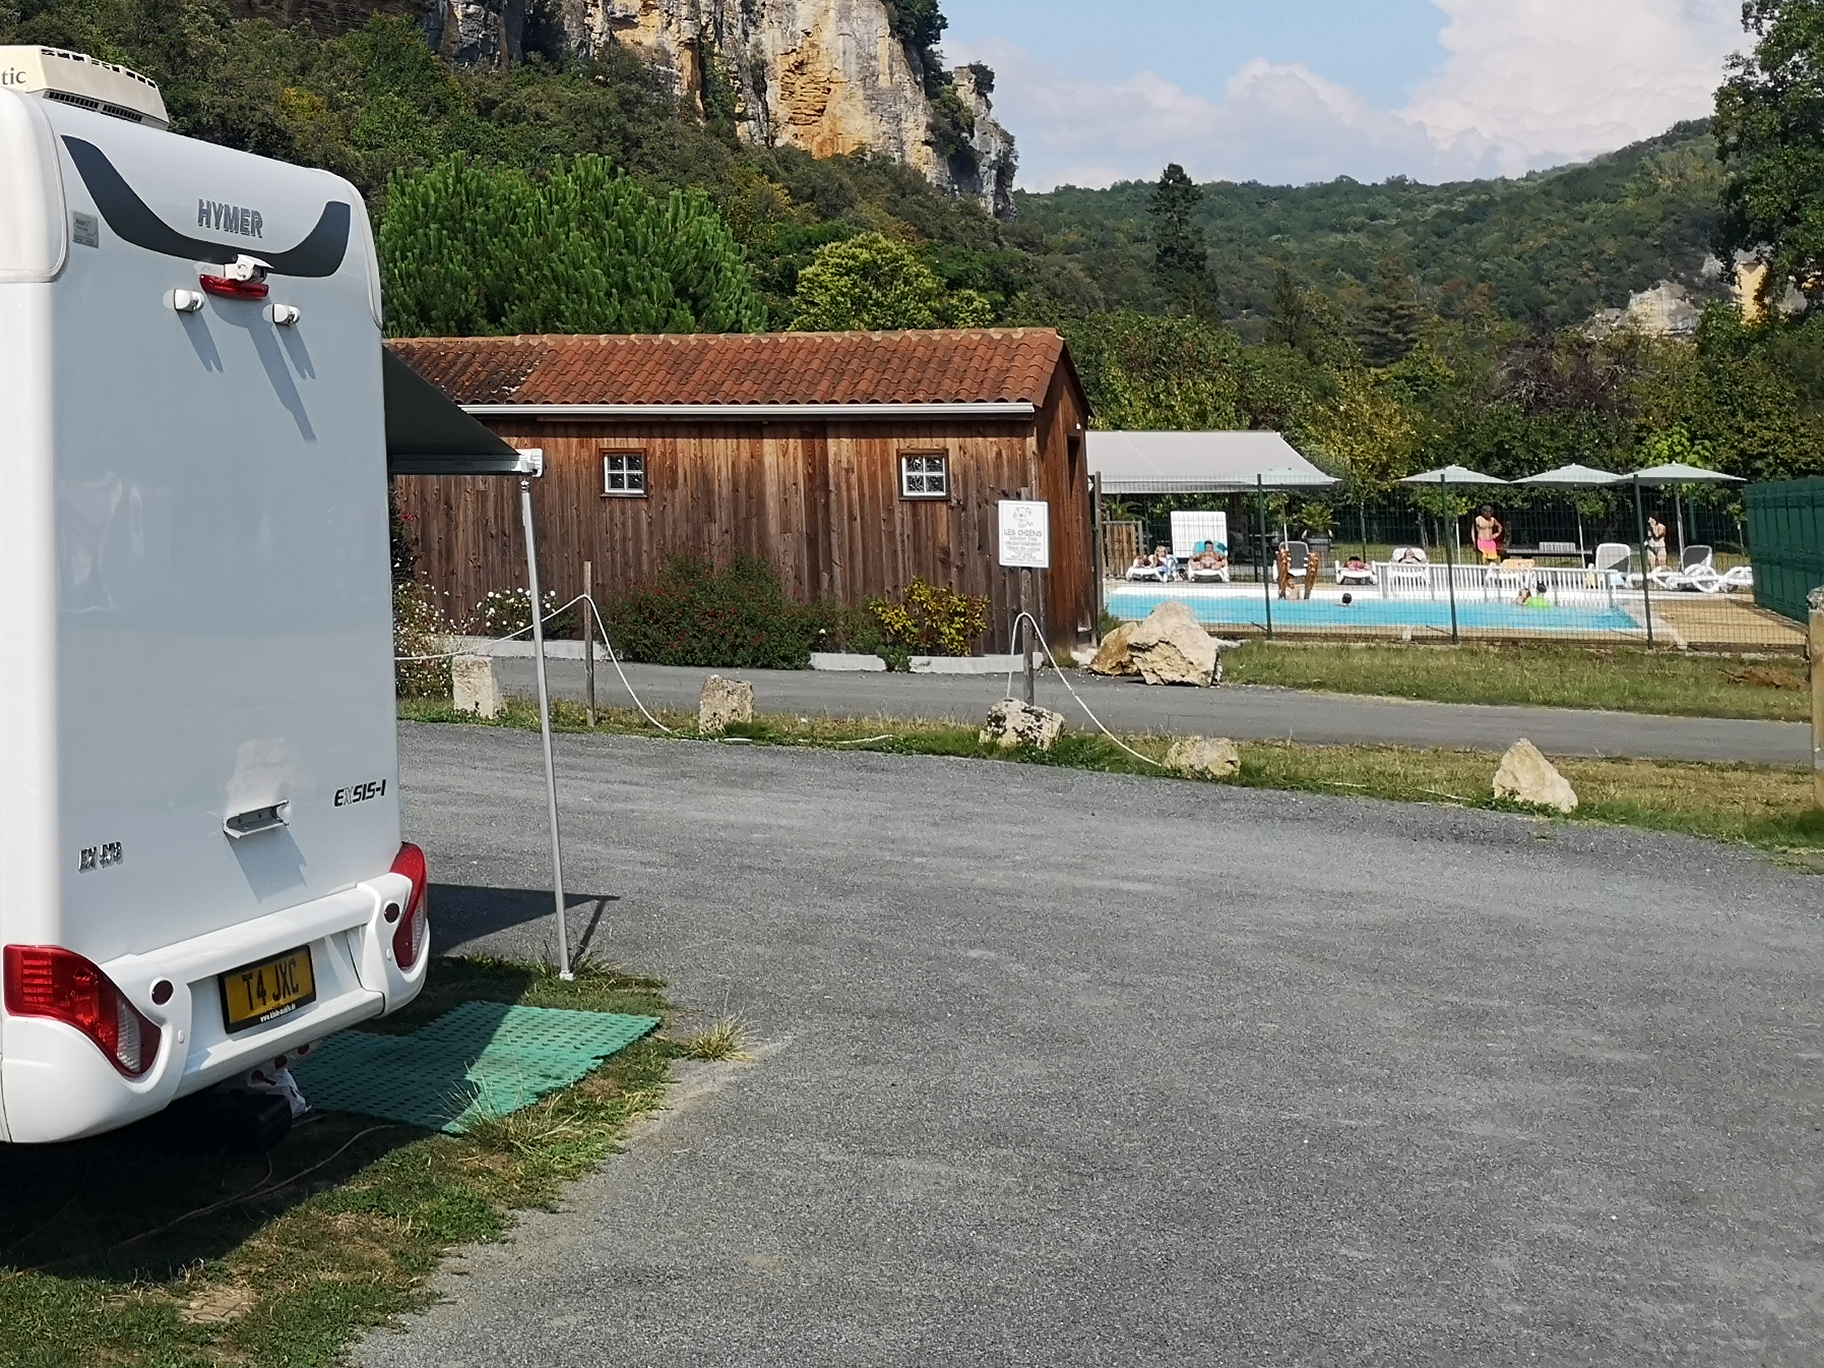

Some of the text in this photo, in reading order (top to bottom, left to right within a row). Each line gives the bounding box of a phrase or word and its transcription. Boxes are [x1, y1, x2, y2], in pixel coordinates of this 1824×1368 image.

[198, 198, 263, 238] HYMER
[1017, 529, 1043, 537] CHIENS
[334, 778, 387, 807] EXSIS-I
[242, 957, 300, 1011] T4 JXC
